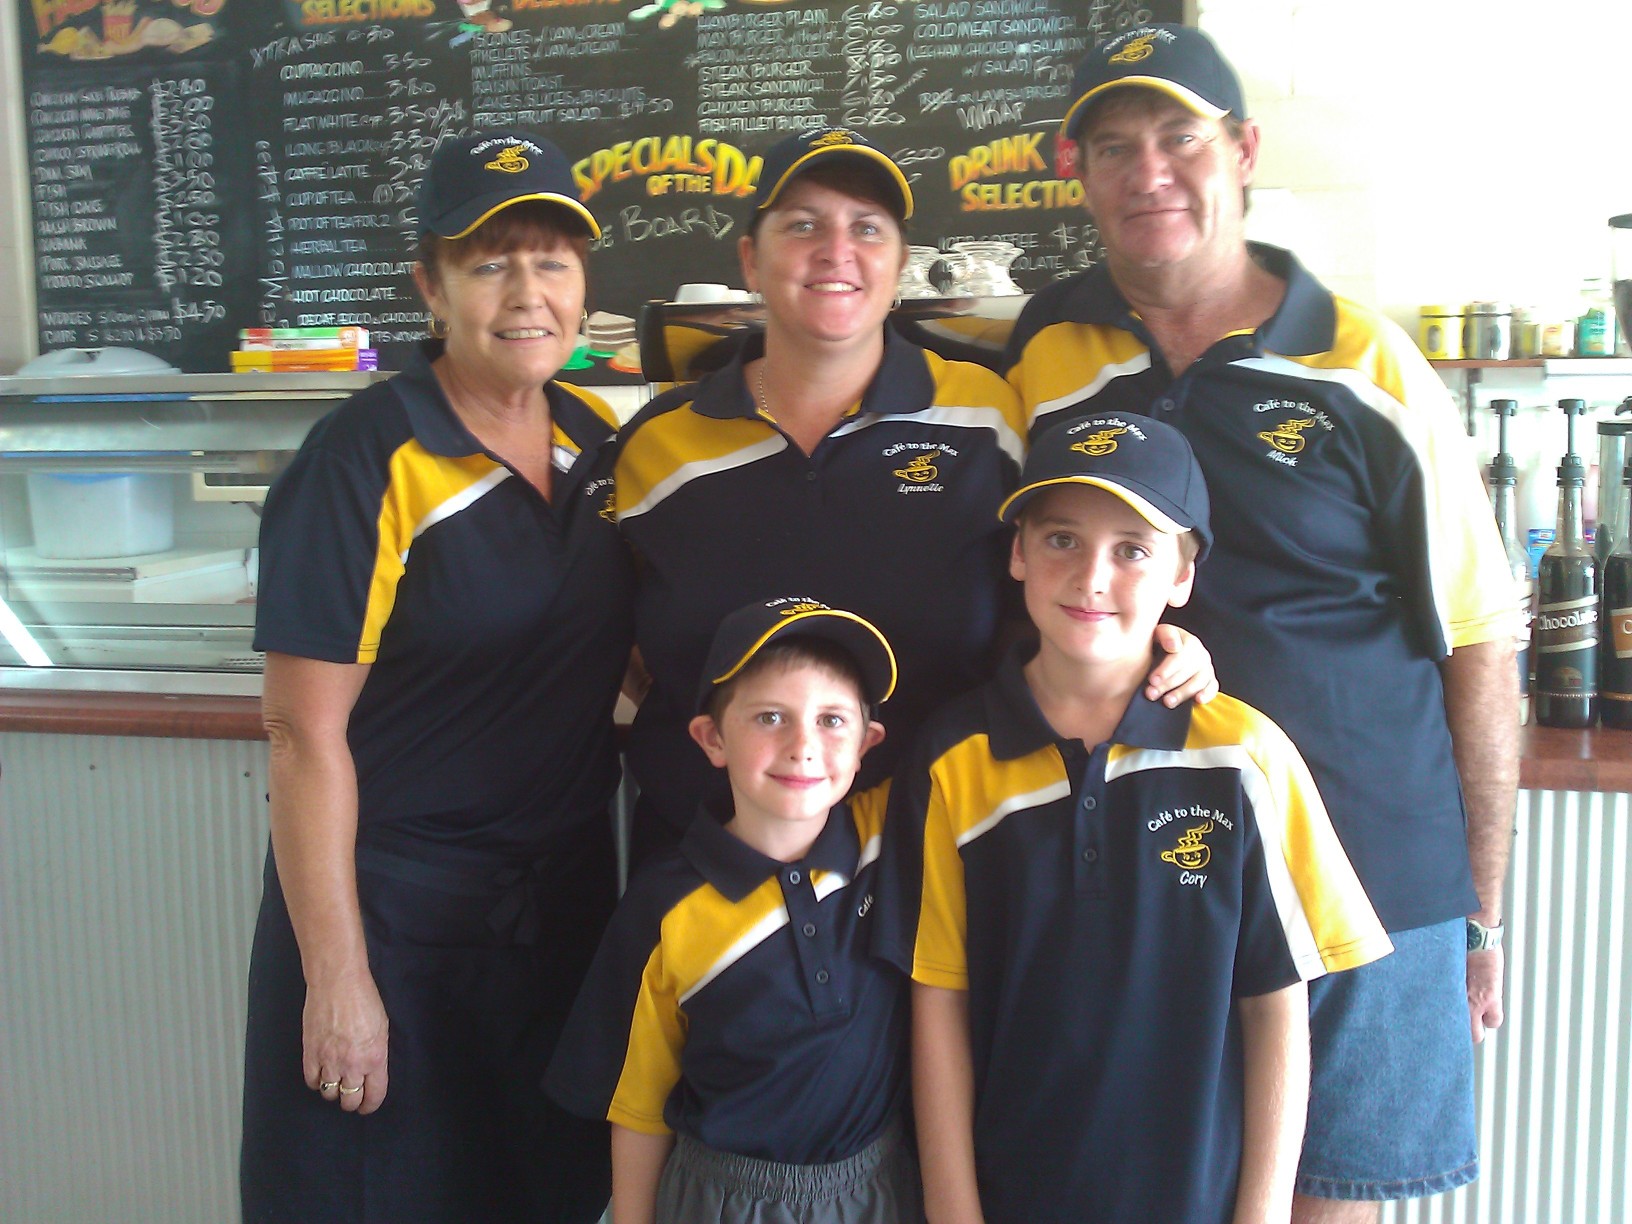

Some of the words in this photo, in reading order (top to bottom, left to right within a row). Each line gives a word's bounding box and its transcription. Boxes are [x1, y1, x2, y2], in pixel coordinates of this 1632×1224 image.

[914, 1, 969, 20] SALAD
[913, 23, 957, 40] COLD
[698, 65, 750, 82] STEAK
[751, 60, 815, 79] BURGER
[698, 82, 751, 98] STEAK
[754, 79, 824, 96] SANDWICH
[571, 135, 717, 202] SPECIALS
[646, 174, 673, 196] OF
[673, 173, 712, 194] THE
[948, 132, 1048, 191] DRINK
[961, 179, 1089, 212] SELECTIO
[620, 205, 735, 242] BOARD
[294, 288, 321, 304] HOT
[322, 287, 396, 303] CHOCOLATE
[1147, 810, 1173, 832] Café
[1175, 808, 1188, 819] to
[1190, 804, 1211, 818] the
[1211, 809, 1234, 831] Max
[1179, 870, 1208, 889] Cory
